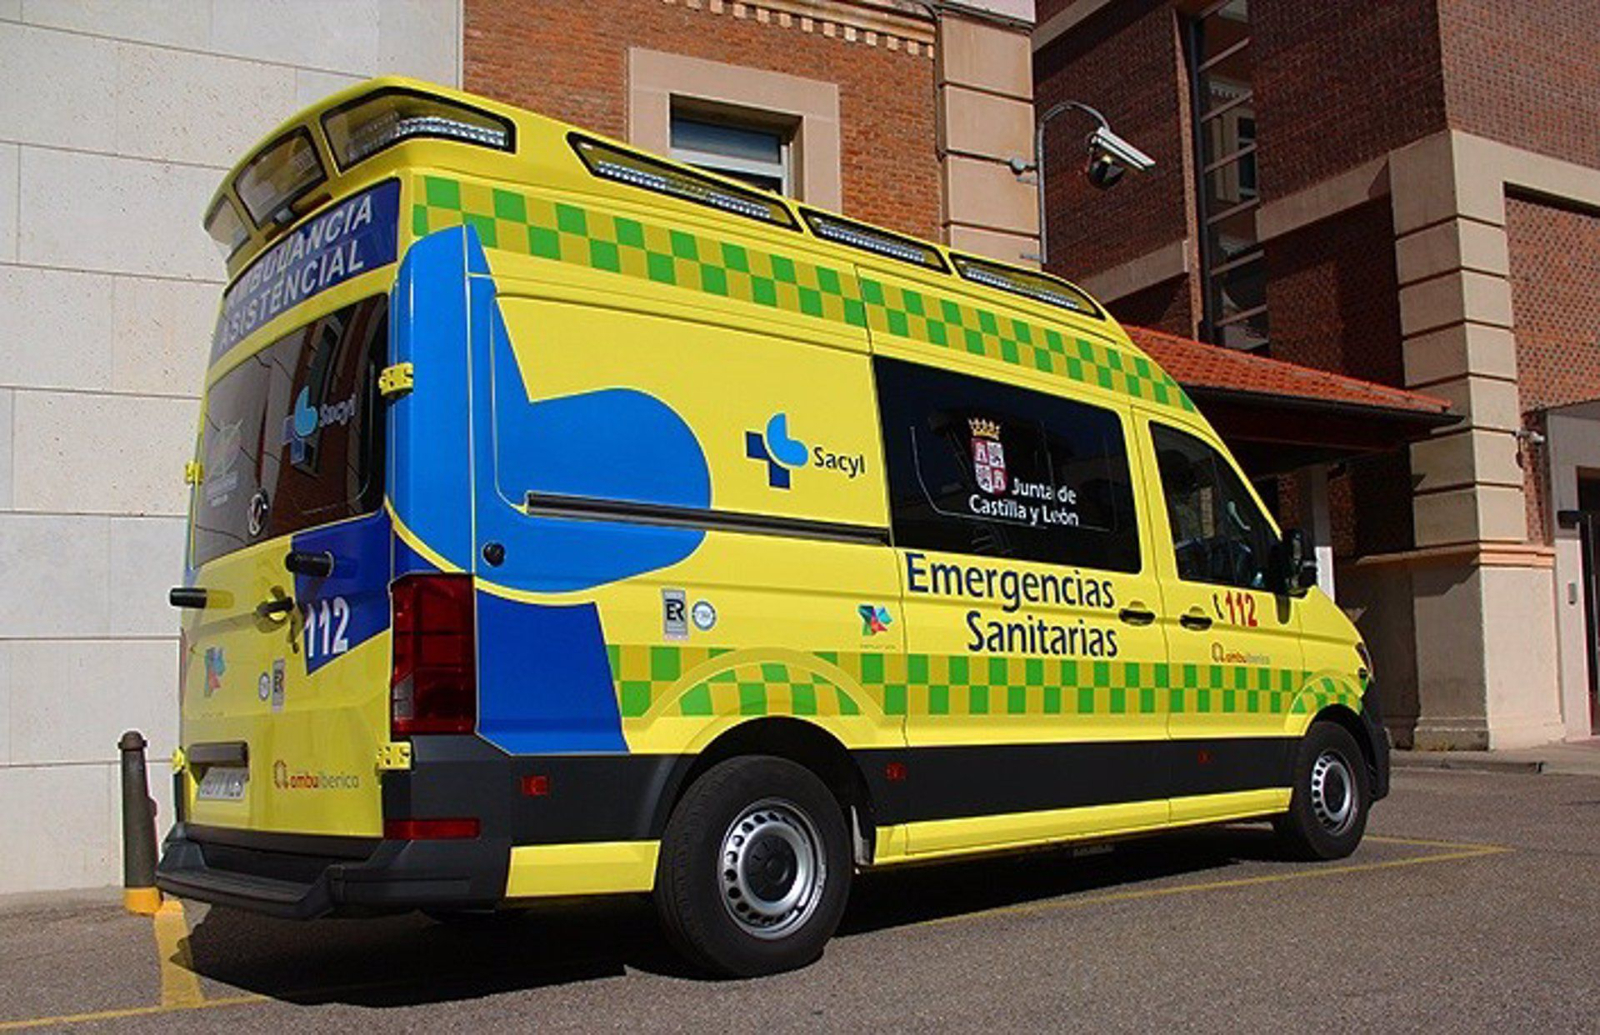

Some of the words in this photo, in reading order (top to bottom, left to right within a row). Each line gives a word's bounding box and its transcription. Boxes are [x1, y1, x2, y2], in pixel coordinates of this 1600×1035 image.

[219, 240, 364, 351] ASISTENCIAL
[320, 394, 356, 427] Sacyl
[813, 446, 865, 479] Sacyl
[1012, 477, 1054, 500] Junta
[1057, 485, 1077, 504] de
[969, 494, 1026, 518] Castilla
[1030, 507, 1040, 526] y
[1042, 505, 1079, 526] León
[905, 552, 1115, 612] Emergencias
[665, 598, 685, 621] ER
[1226, 590, 1258, 627] 112
[304, 597, 349, 658] 112
[966, 611, 1118, 657] Sanitarias
